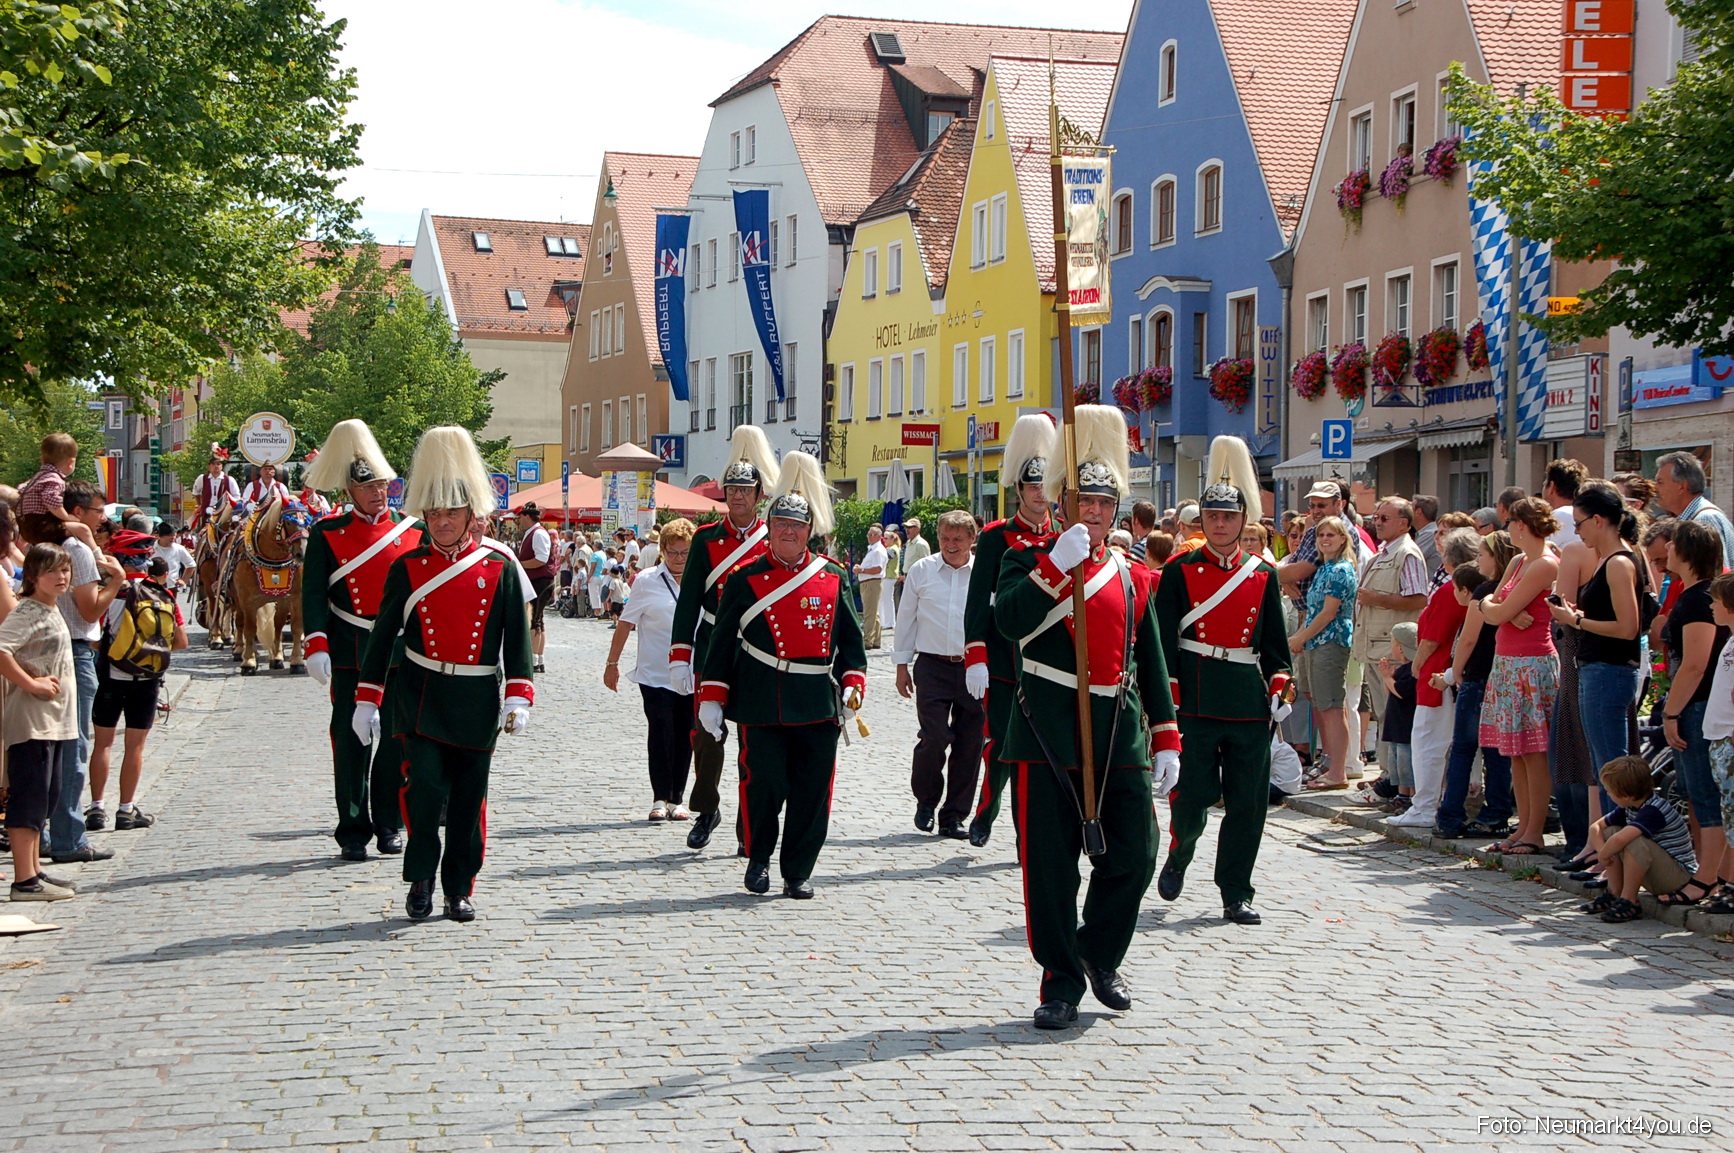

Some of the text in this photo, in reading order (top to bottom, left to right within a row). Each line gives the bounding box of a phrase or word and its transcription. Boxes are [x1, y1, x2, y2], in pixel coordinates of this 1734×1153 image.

[755, 270, 779, 343] RUPPERT
[876, 318, 938, 349] HOTEL Lehmeier
[1261, 347, 1277, 425] WITTL
[1590, 358, 1601, 431] KINO
[246, 436, 287, 444] Lammsbräu
[903, 430, 936, 439] WISSMAC
[969, 420, 974, 446] P
[1329, 424, 1346, 454] P
[872, 445, 909, 462] Restaurant
